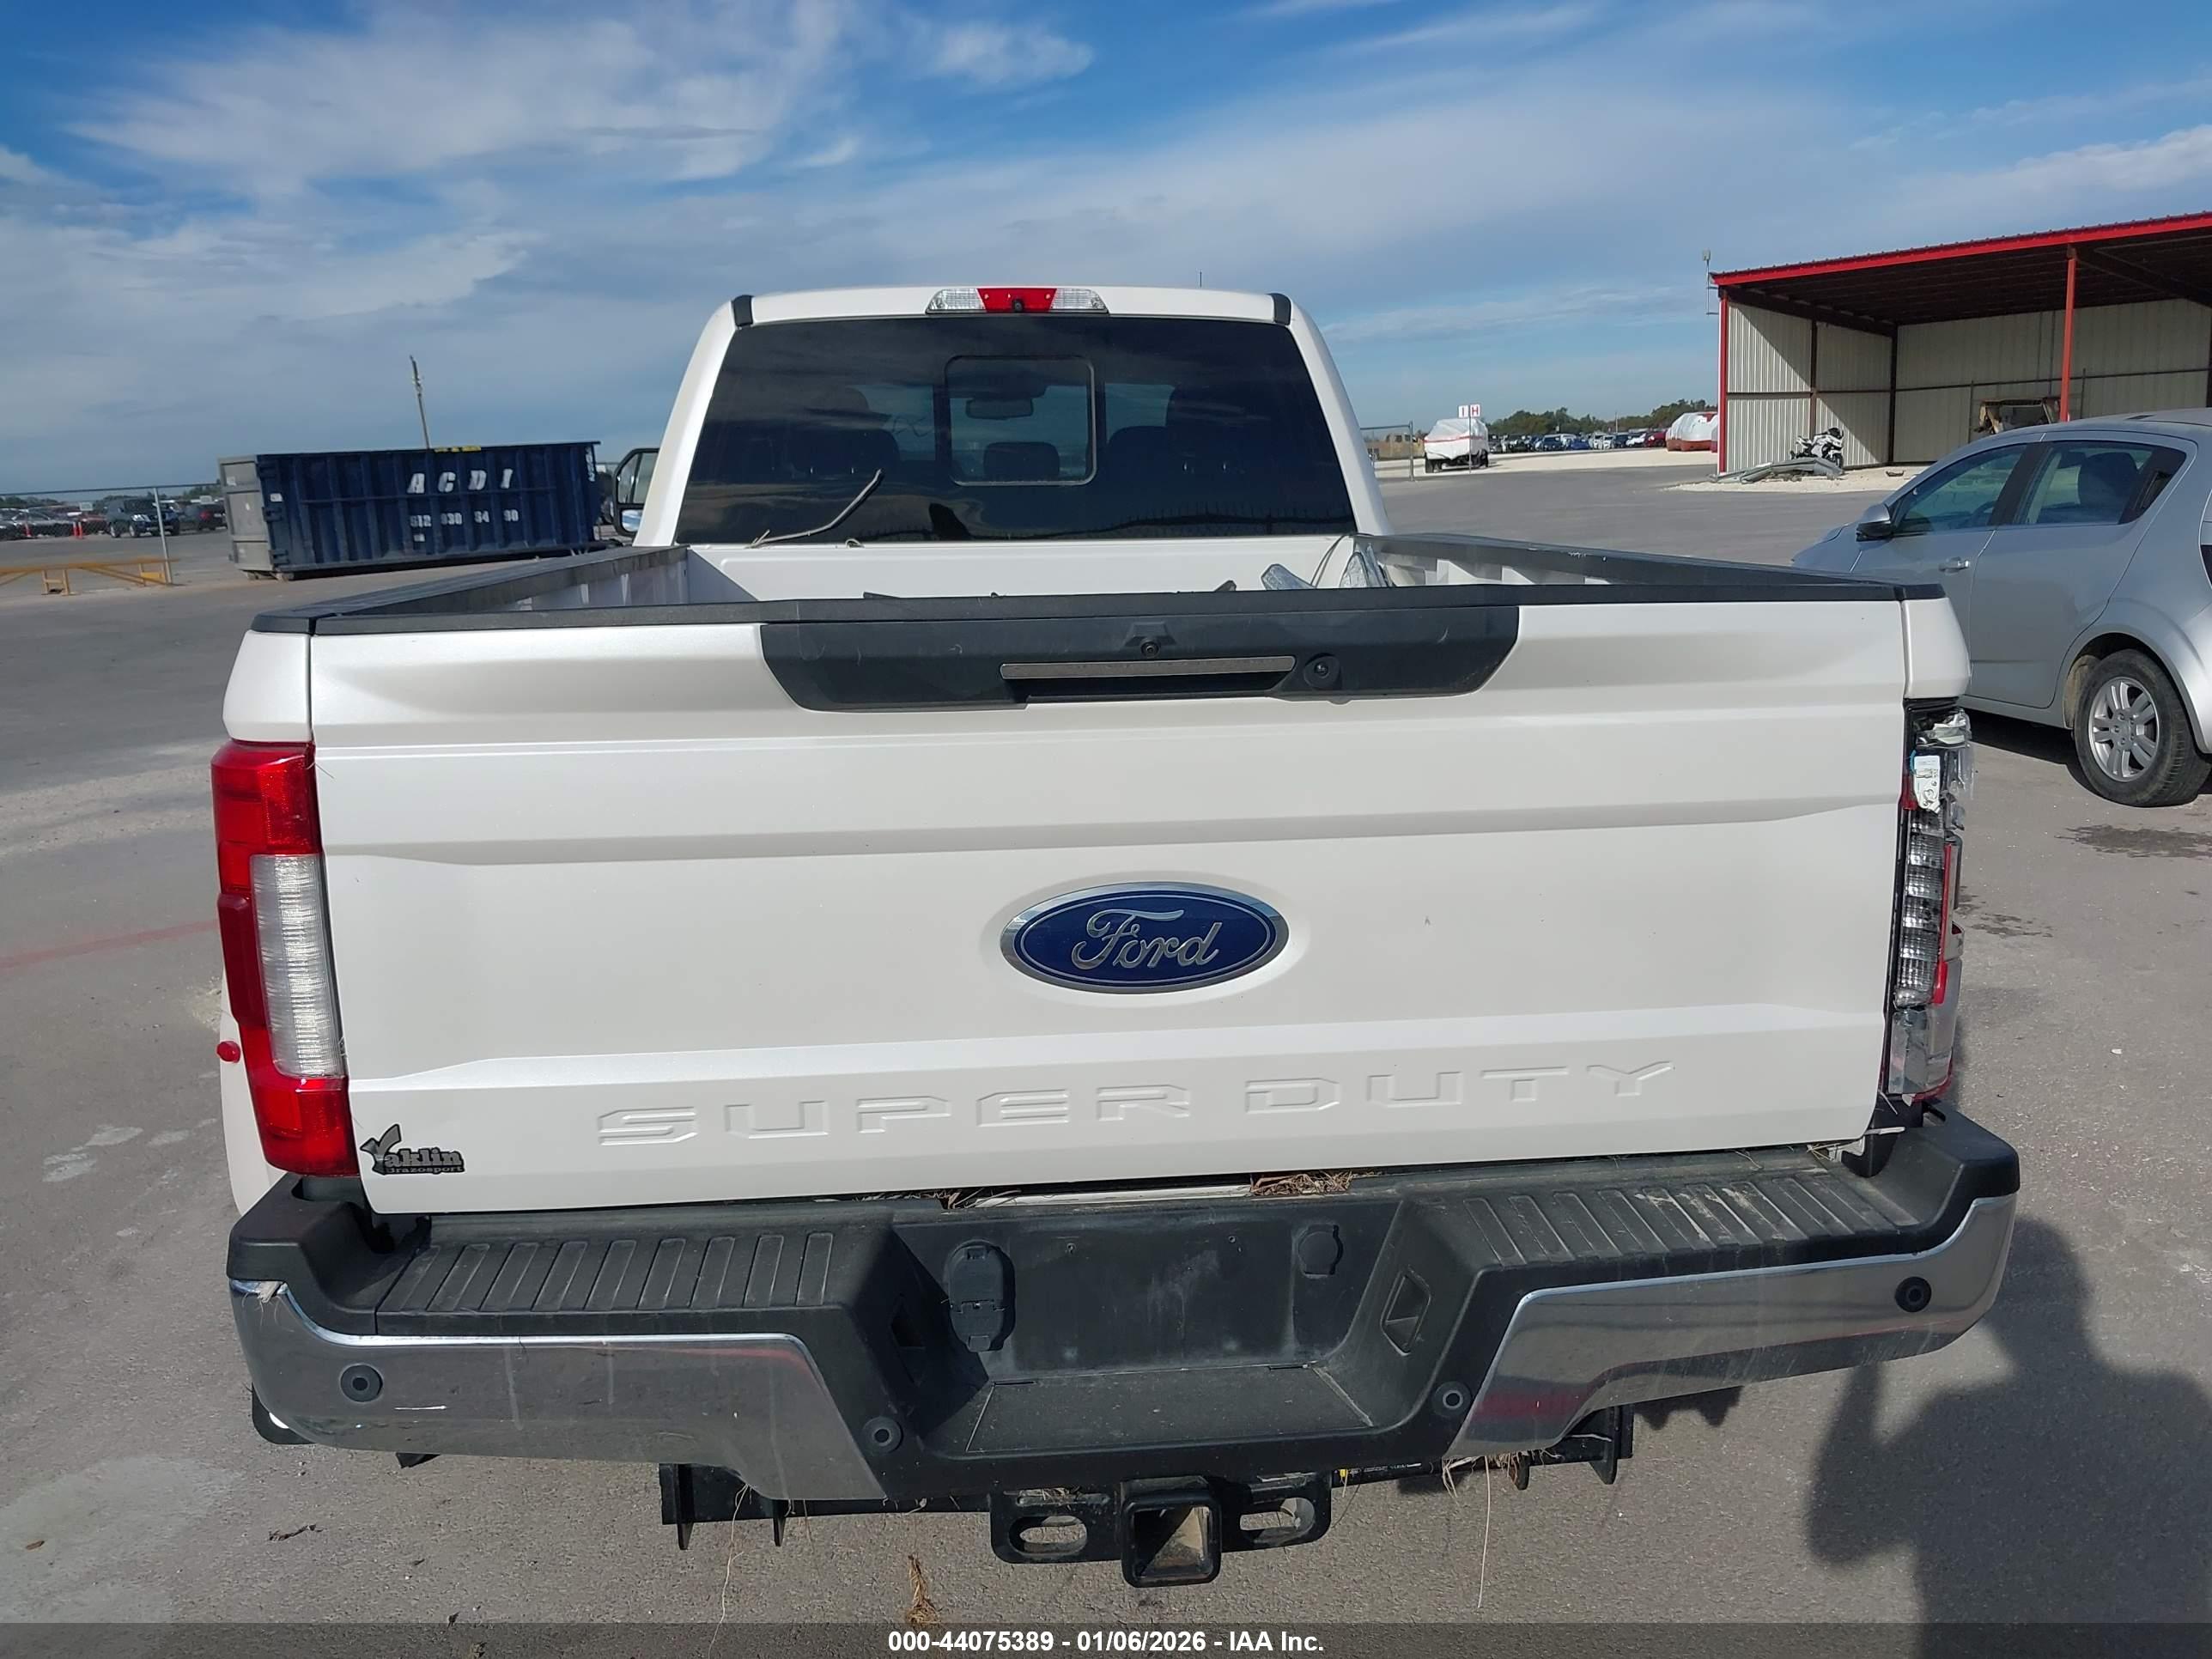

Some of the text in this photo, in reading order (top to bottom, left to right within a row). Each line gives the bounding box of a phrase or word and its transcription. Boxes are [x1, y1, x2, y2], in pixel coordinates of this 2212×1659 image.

[1072, 908, 1223, 969] Ford
[599, 1061, 1675, 1146] SUPER DUTY
